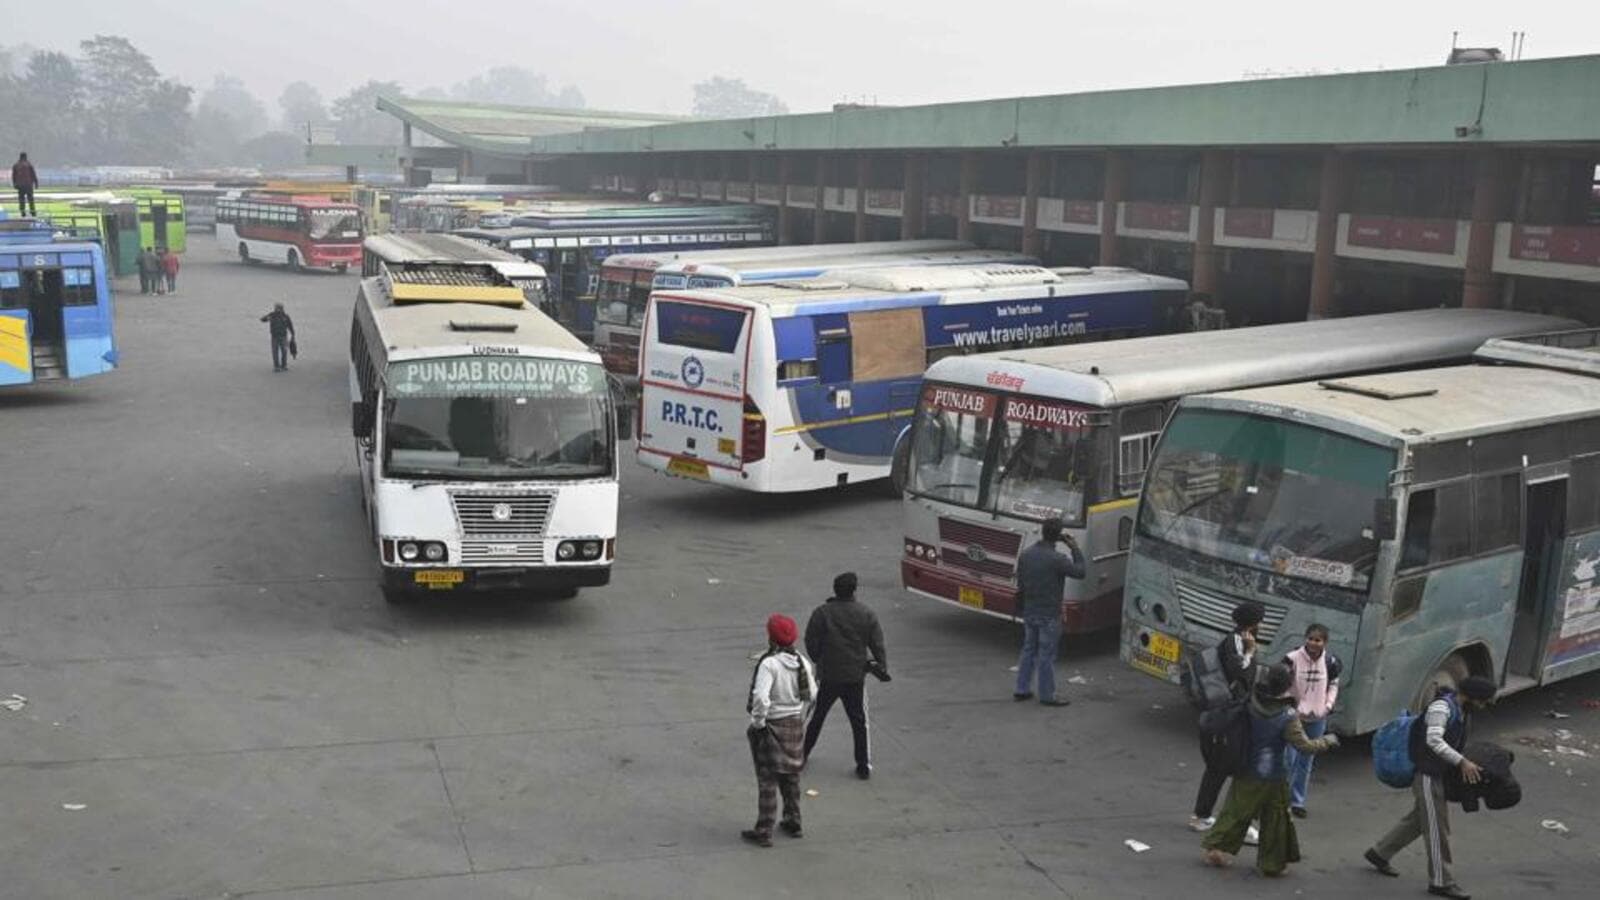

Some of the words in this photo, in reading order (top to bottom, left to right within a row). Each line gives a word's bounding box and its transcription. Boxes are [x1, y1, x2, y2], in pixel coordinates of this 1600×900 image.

[407, 361, 482, 382] PUNJAB
[487, 362, 589, 385] ROADWAYS
[662, 400, 723, 432] P.R.T.C.
[934, 389, 985, 413] PUNJAB
[1006, 401, 1088, 428] ROADWAYS
